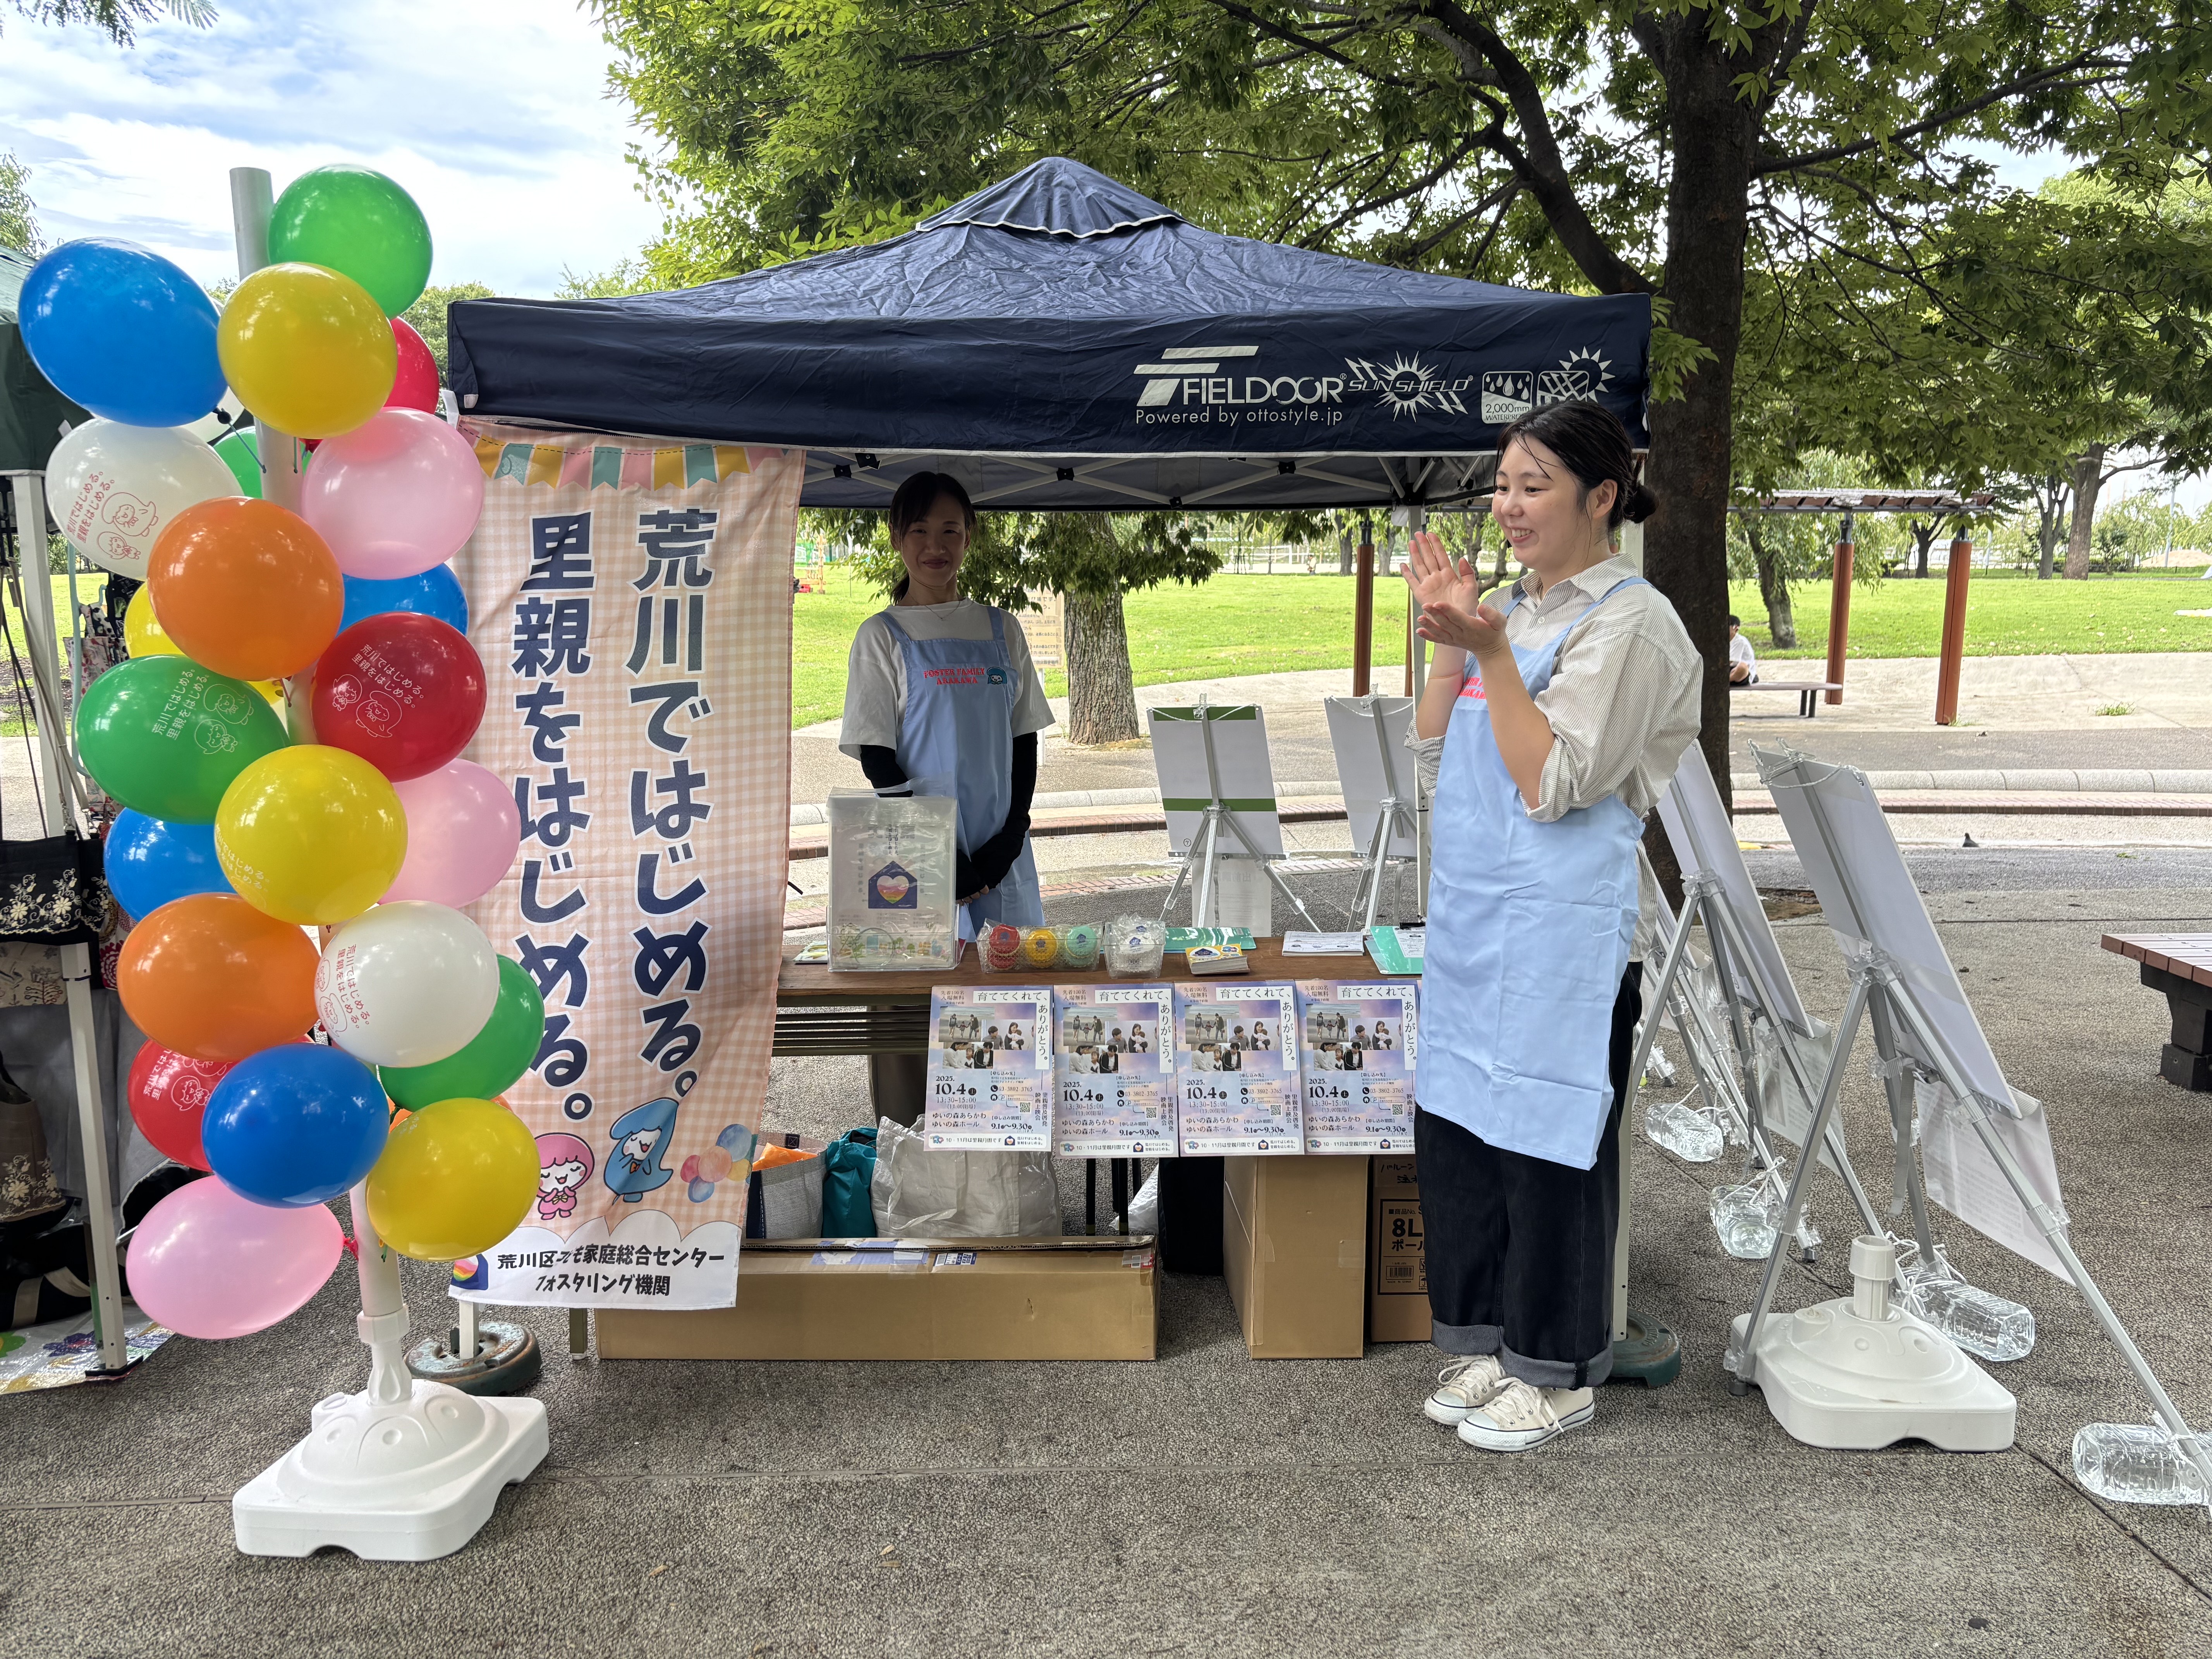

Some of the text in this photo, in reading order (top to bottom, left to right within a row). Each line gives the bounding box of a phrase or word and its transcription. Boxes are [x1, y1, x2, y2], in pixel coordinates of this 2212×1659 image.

[1136, 405, 1343, 426] Powered by ottostyle.jp
[1486, 404, 1530, 414] 2,000mm
[67, 471, 103, 536] 荒川ではじめる。
[352, 653, 416, 708] 里親をはじめる。
[360, 644, 424, 699] 荒川ではじめる。
[152, 669, 195, 736] 荒川ではじめる。
[166, 675, 210, 740] 里親をはじめる。
[510, 510, 598, 1121] 里親をはじめる。
[624, 507, 720, 1097] 荒川ではじめる。
[336, 948, 360, 1029] 里親をはじめる。
[347, 944, 370, 1025] 荒川ではじめる。
[1099, 990, 1169, 1001] 育ててくれて、
[1220, 988, 1290, 999] 育ててくれて、
[1341, 987, 1413, 998] 育ててくれて、
[1161, 1004, 1171, 1063] ありがとう。
[1282, 1001, 1295, 1060] ありがとう。
[1404, 1001, 1417, 1060] ありがとう。
[935, 1083, 966, 1094] 10.4
[1063, 1089, 1093, 1101] 10.4
[1187, 1087, 1217, 1099] 10.4
[1309, 1086, 1339, 1098] 10.4
[535, 1273, 671, 1297] フォスタリング機関
